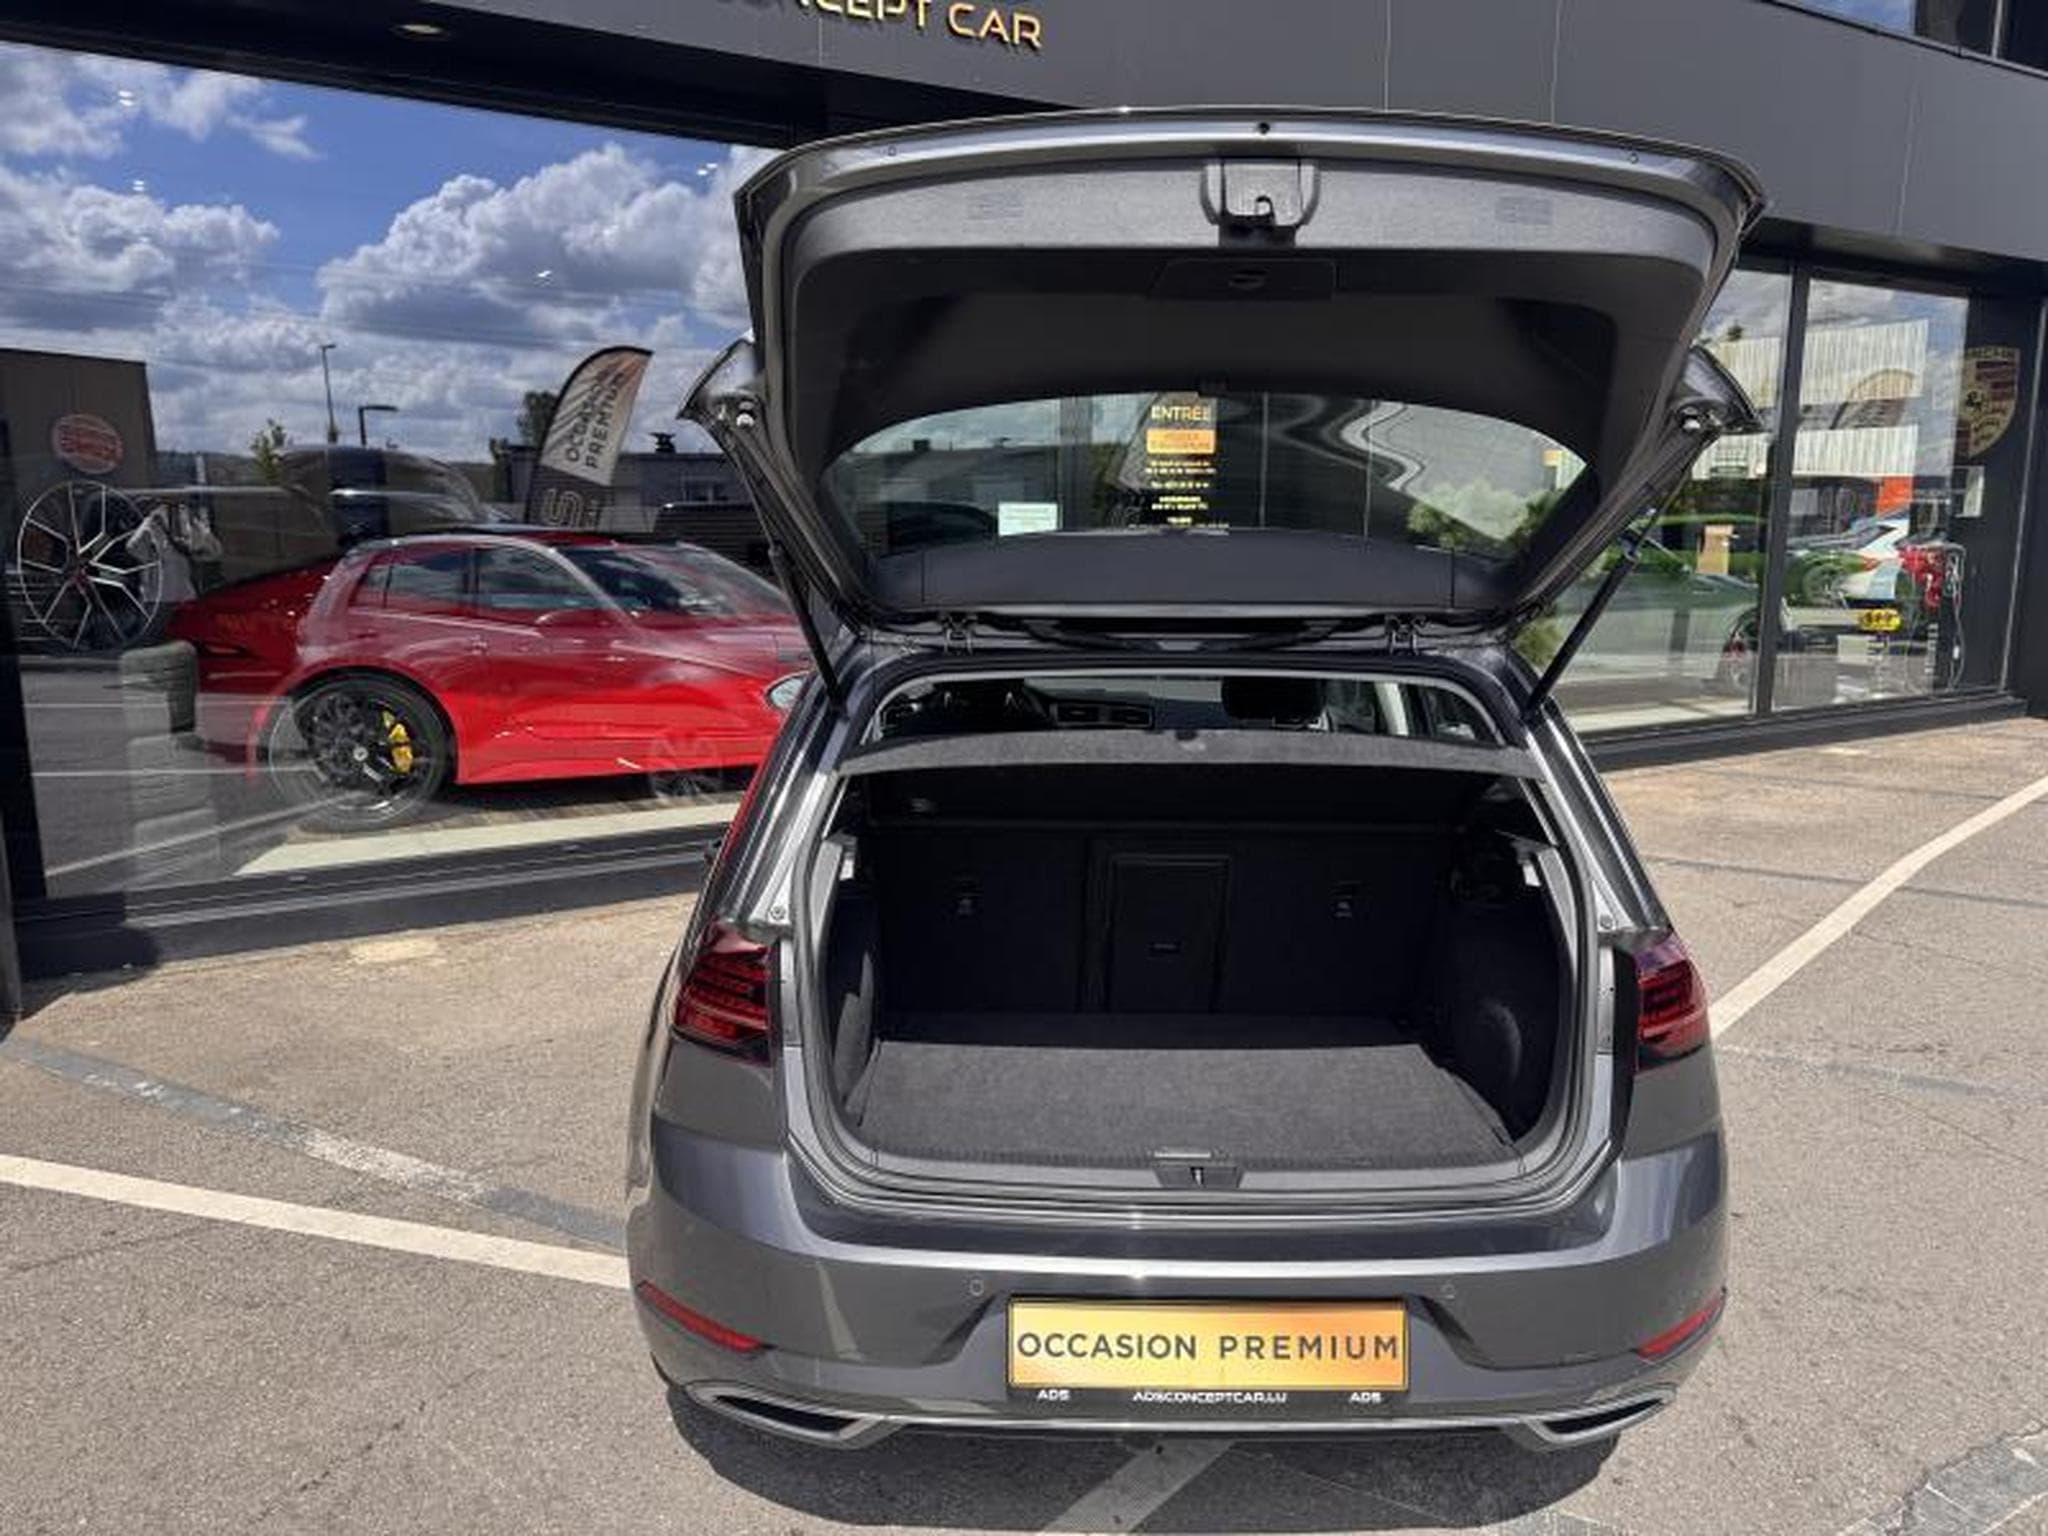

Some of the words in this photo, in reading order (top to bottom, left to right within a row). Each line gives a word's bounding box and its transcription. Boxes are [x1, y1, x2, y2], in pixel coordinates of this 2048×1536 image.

[948, 3, 1042, 49] CAR
[1017, 1332, 1197, 1360] OCCASION
[1219, 1334, 1398, 1361] PREMIUM
[1037, 1389, 1071, 1401] ADS
[1349, 1391, 1382, 1404] ADS
